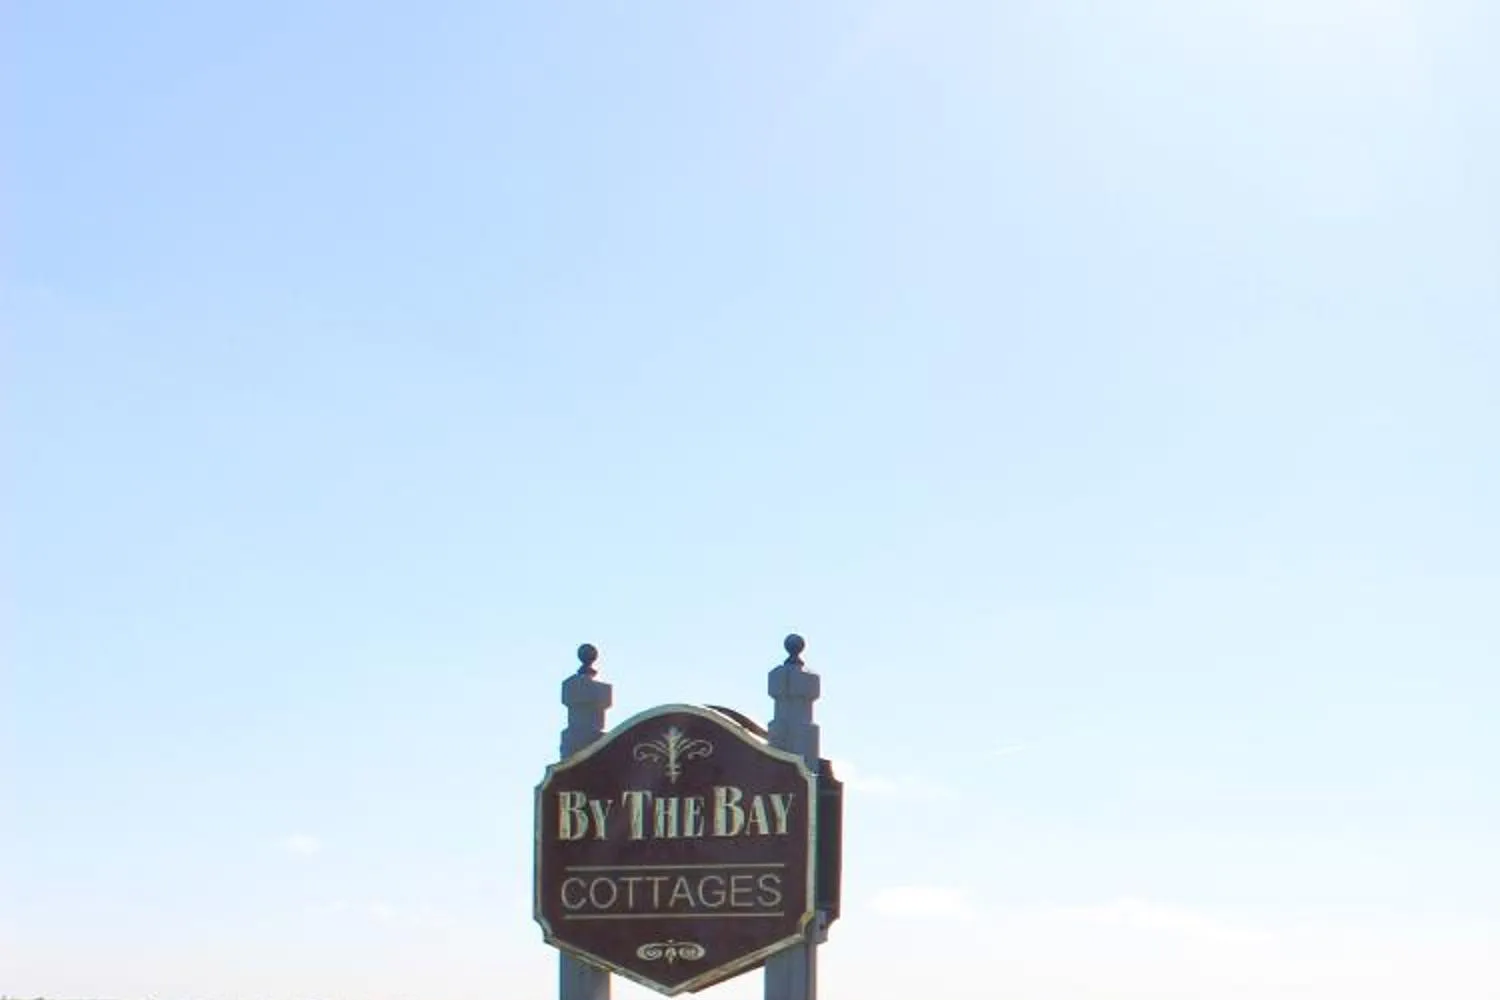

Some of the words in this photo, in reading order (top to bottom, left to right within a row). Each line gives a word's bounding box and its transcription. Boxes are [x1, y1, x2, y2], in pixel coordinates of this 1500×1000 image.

[556, 791, 613, 841] BY
[623, 789, 705, 840] THE
[712, 785, 796, 837] BAY
[560, 873, 782, 909] COTTAGES
